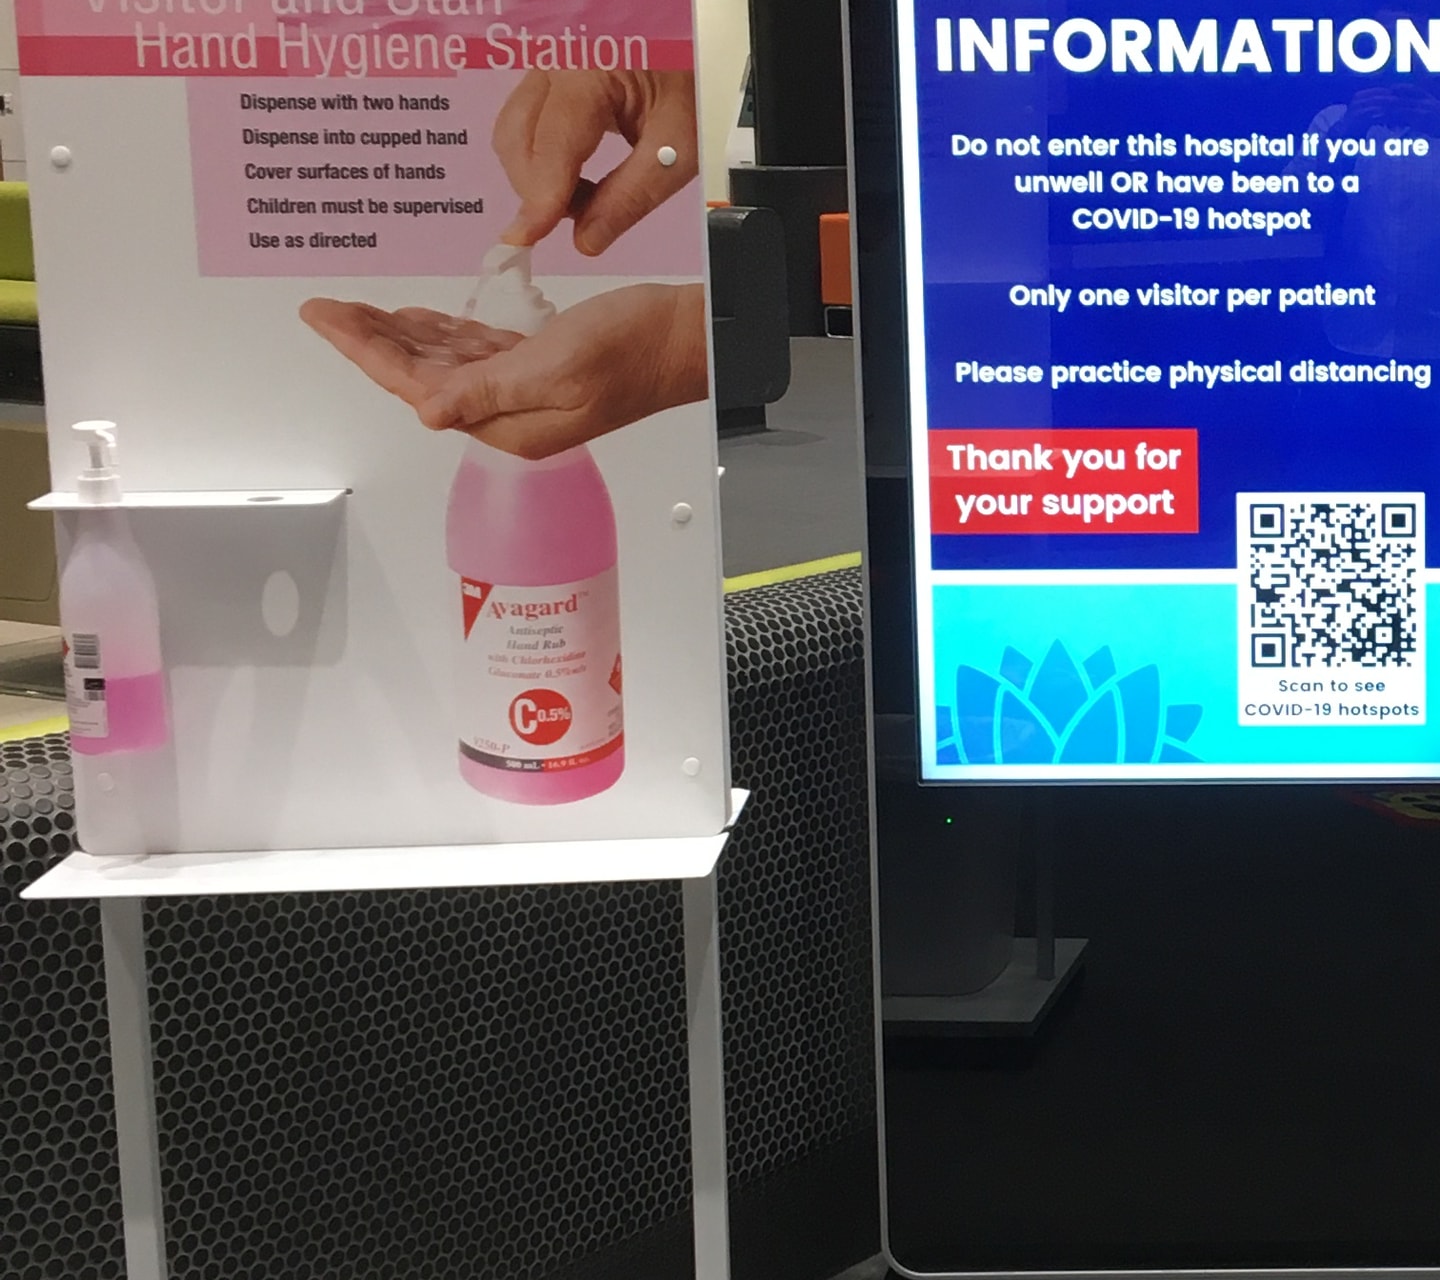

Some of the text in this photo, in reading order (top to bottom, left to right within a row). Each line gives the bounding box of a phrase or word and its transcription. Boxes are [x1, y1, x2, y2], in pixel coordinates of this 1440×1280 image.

[135, 21, 649, 79] Hand Hygiene Station
[241, 94, 449, 113] Dispense with two hands
[243, 129, 468, 148] Dispense into cupped hand
[952, 133, 1429, 162] Do not enter this hospital if you are
[245, 163, 445, 179] Cover surfaces of hands
[1015, 171, 1359, 193] unwell OR have been to a
[247, 198, 483, 217] Children must be supervised
[1073, 207, 1311, 236] COVID-19 hotspot
[250, 232, 377, 248] Use as directed
[1010, 283, 1375, 312] Only one visitor per patient
[956, 360, 1431, 389] Please practice physical distancing
[947, 442, 1181, 478] Thank you for
[955, 490, 1174, 523] your support
[543, 639, 566, 650] Rub
[1279, 680, 1385, 692] Scan to see
[537, 707, 571, 723] 0.5%
[1245, 703, 1419, 720] COVID-19 hotspots
